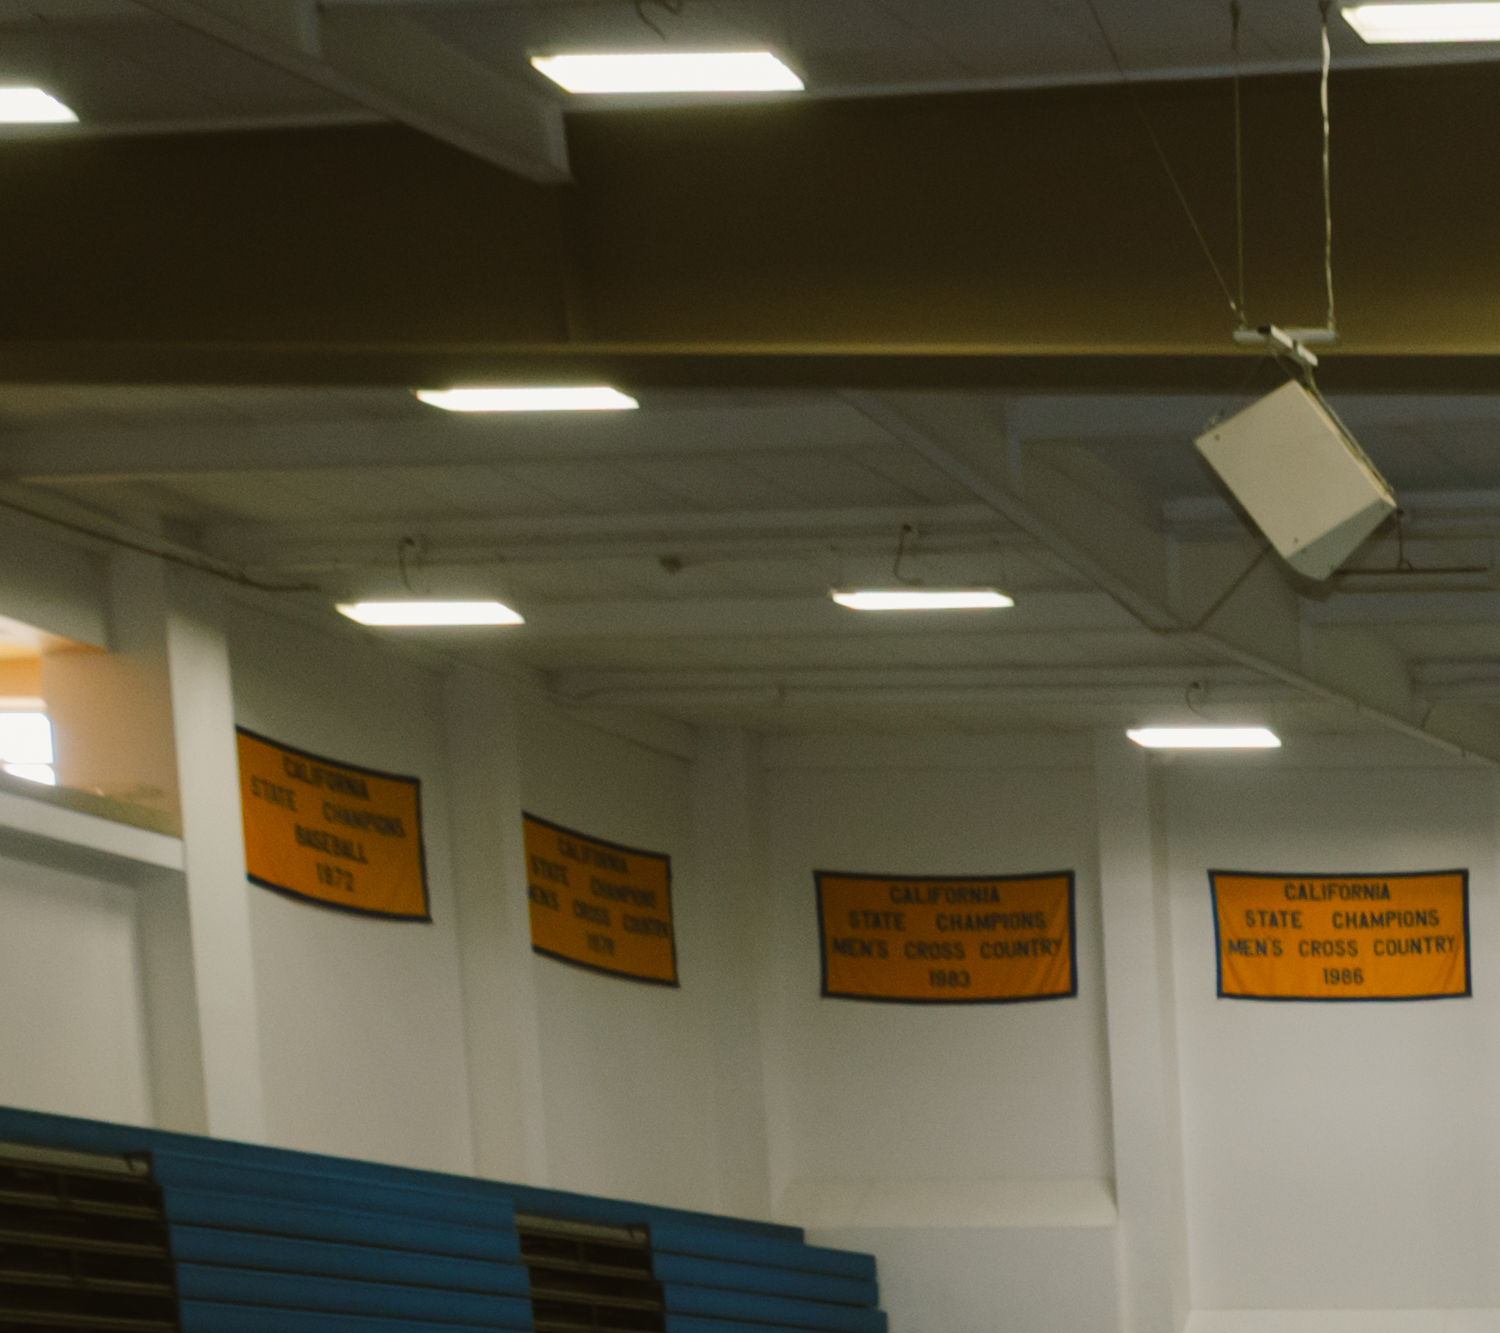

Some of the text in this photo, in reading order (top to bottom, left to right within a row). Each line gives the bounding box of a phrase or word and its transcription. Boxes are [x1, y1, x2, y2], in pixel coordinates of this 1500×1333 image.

[889, 886, 1001, 904] CALIFORNIA
[1284, 883, 1391, 901] CALIFORNIA
[848, 911, 1047, 932] STATE CHAMPIONS
[1245, 910, 1439, 929] STATE CHAMPIONS
[903, 941, 966, 960] CROSS
[1228, 937, 1455, 957] MEN'S CROSS COUNTRY
